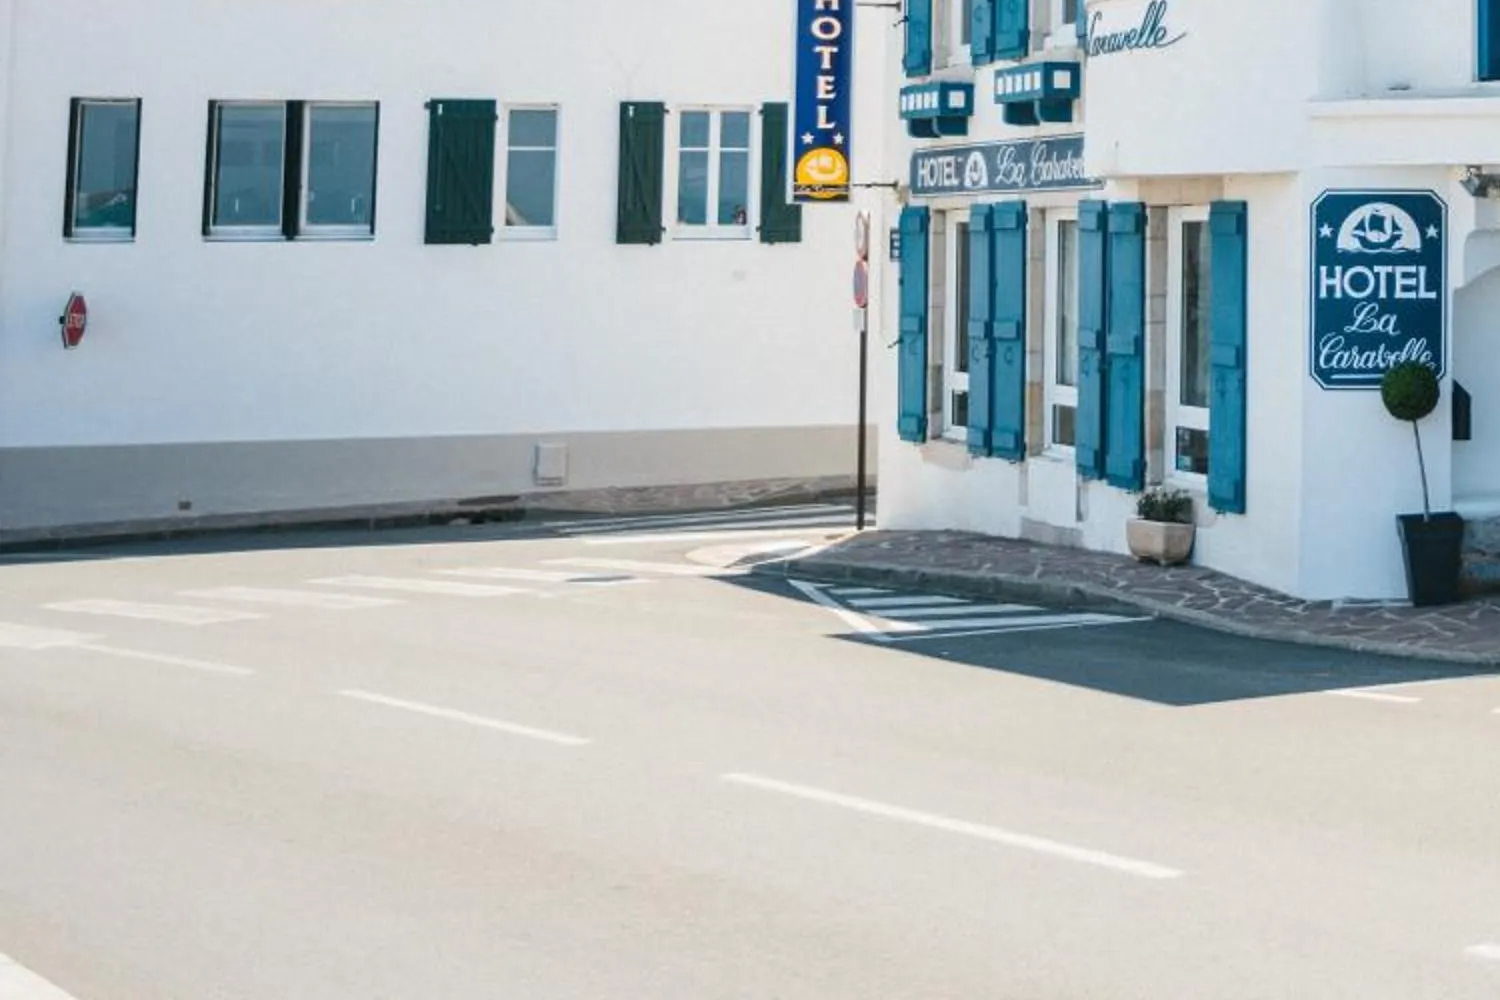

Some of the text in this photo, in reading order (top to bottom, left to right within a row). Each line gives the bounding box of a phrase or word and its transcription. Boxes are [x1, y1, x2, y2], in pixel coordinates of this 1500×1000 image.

[917, 155, 960, 188] HOTEL
[995, 145, 1027, 187] La
[1319, 265, 1437, 300] HOTEL
[1343, 301, 1400, 336] La
[1319, 332, 1437, 370] Caravelle
